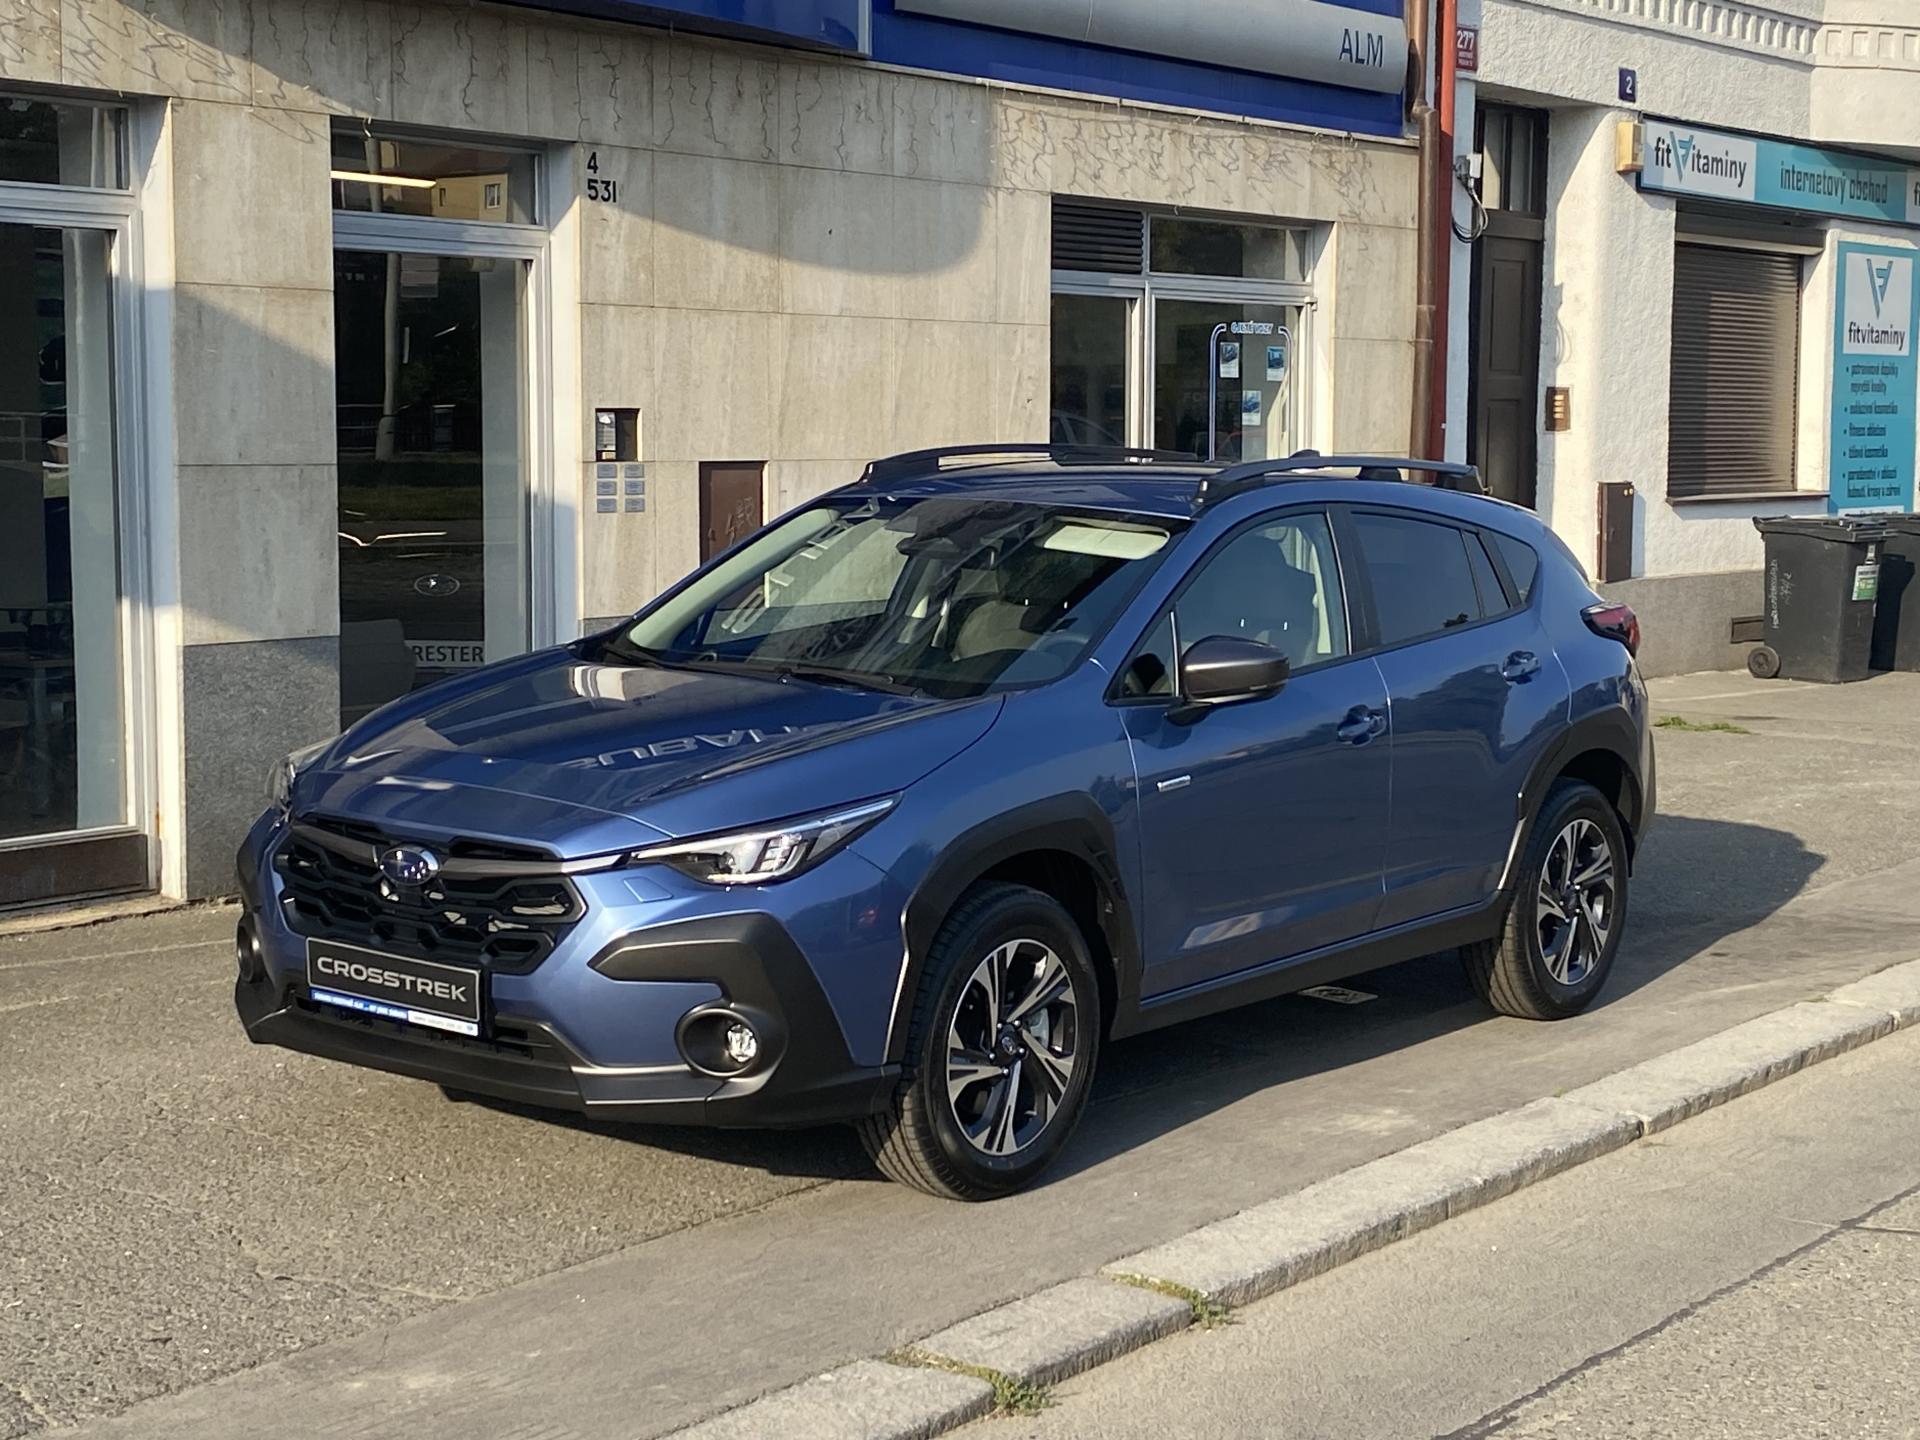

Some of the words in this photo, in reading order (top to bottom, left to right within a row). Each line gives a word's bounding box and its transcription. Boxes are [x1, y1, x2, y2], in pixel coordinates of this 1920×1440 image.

[1339, 28, 1383, 68] ALM
[1457, 30, 1475, 50] 277
[1626, 75, 1633, 94] 2
[587, 151, 599, 174] 4
[587, 178, 617, 203] 531
[1780, 161, 1846, 205] internetový
[1849, 169, 1888, 204] obchod
[1848, 321, 1906, 351] fitvitaminy
[317, 956, 468, 1003] CROSSTREK
